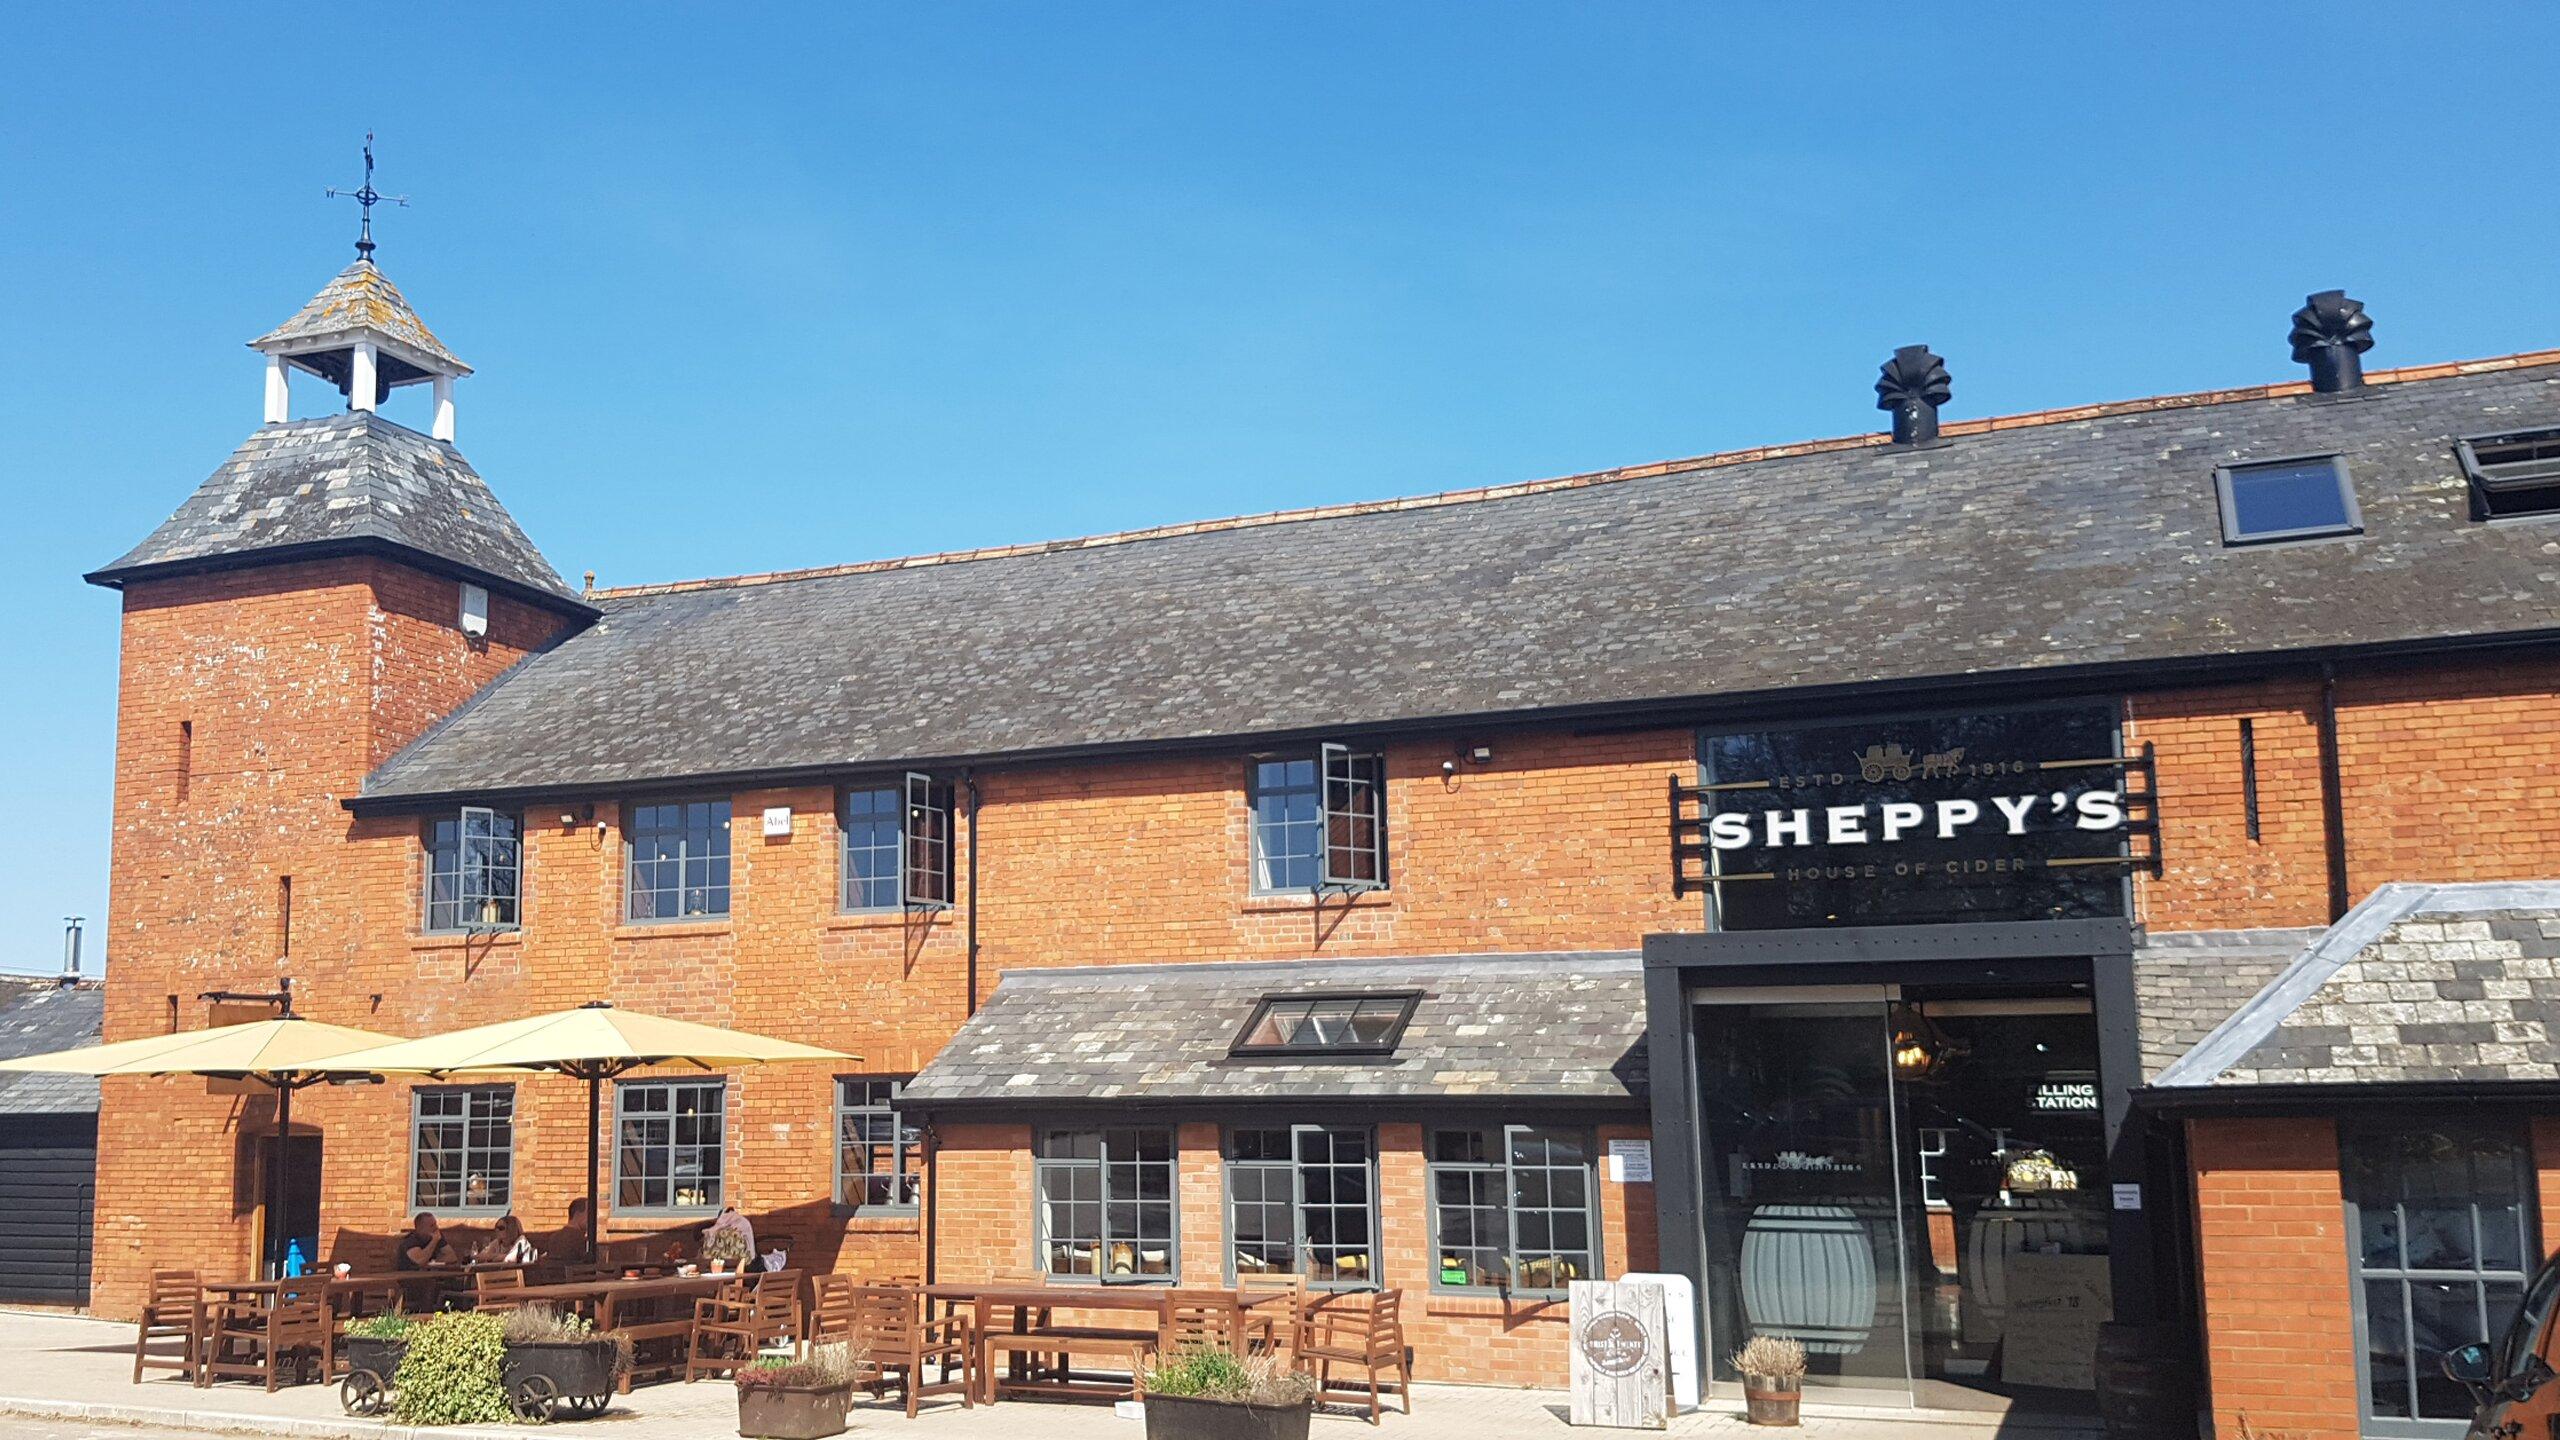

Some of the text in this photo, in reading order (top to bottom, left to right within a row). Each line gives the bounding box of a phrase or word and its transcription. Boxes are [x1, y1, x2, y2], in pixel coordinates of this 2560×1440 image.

[1779, 759, 2025, 789] ESTD 1816
[1710, 789, 2124, 850] SHEPPY'S
[1787, 857, 2026, 881] HOUSE OF CIDER
[2027, 1084, 2095, 1096] ILLING
[2025, 1096, 2098, 1109] TATION
